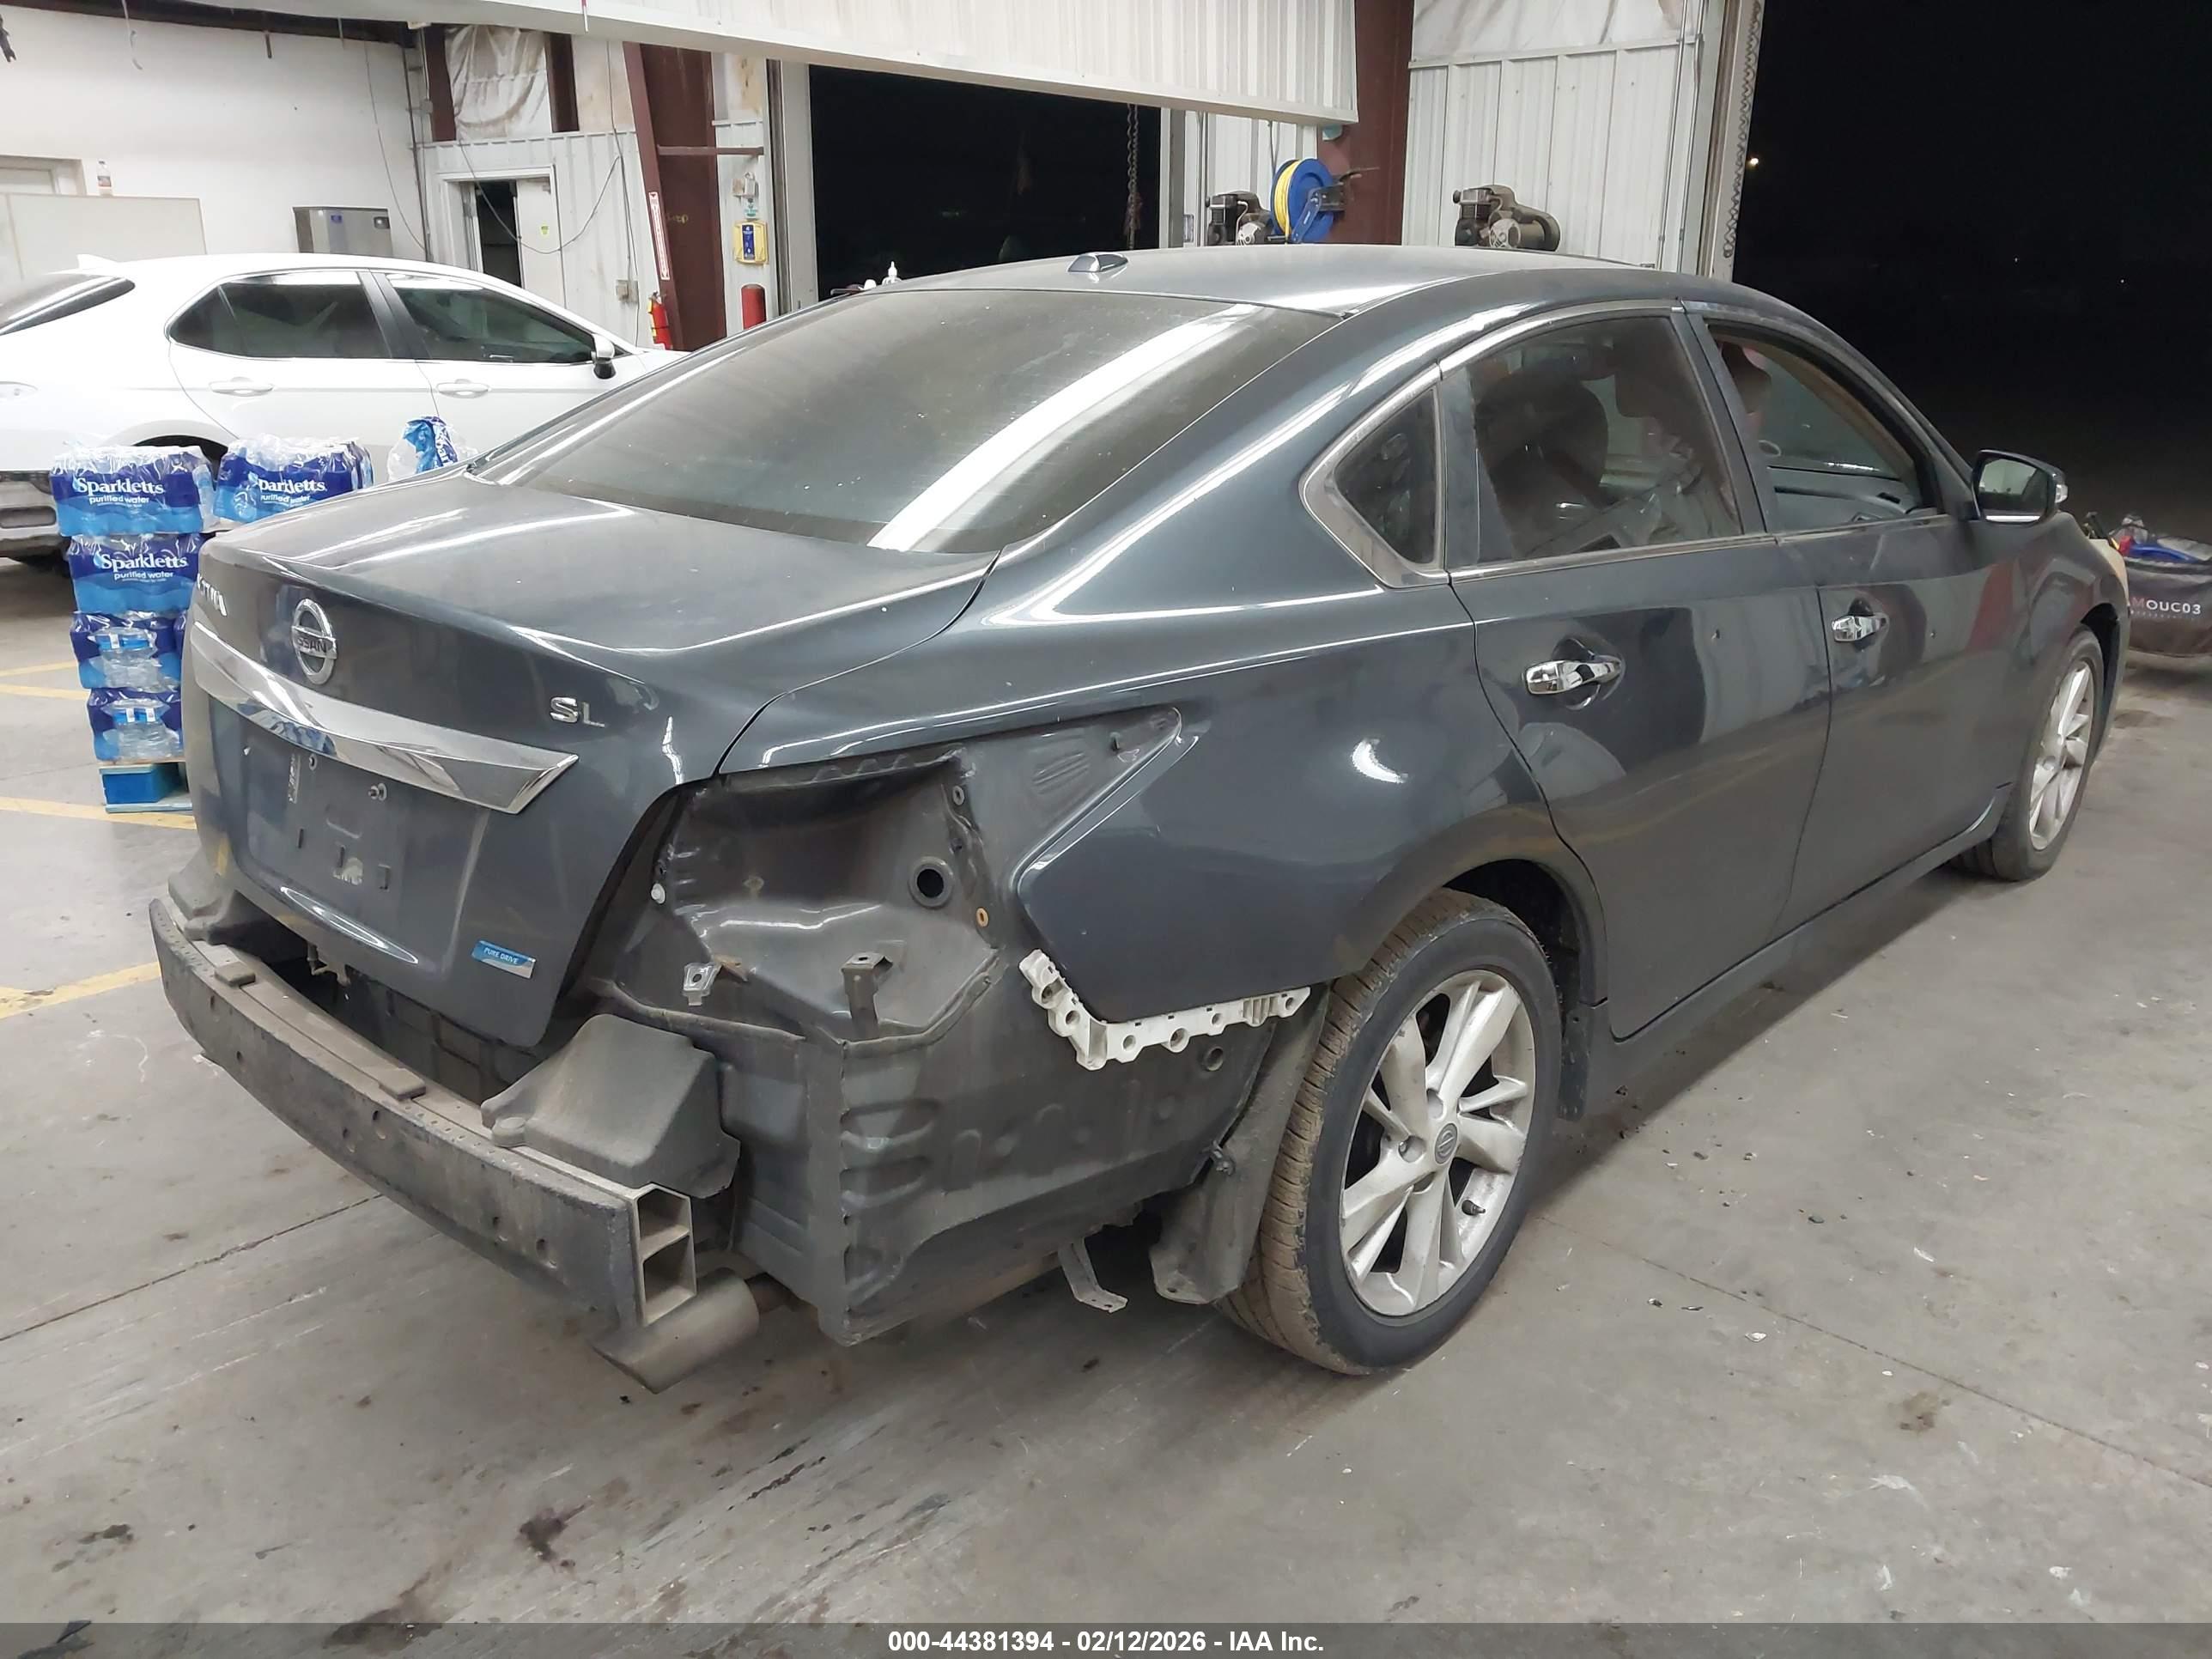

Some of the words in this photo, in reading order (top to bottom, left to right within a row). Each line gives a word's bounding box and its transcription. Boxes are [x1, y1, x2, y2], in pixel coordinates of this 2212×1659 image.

[76, 477, 165, 496] Sparkletts
[258, 478, 325, 494] parkletts
[88, 495, 124, 505] purified
[125, 495, 149, 504] water
[100, 552, 189, 573] Sparkletts
[113, 571, 147, 580] purified
[550, 696, 605, 728] SL
[483, 947, 501, 957] PURE
[500, 953, 520, 964] DRIVE
